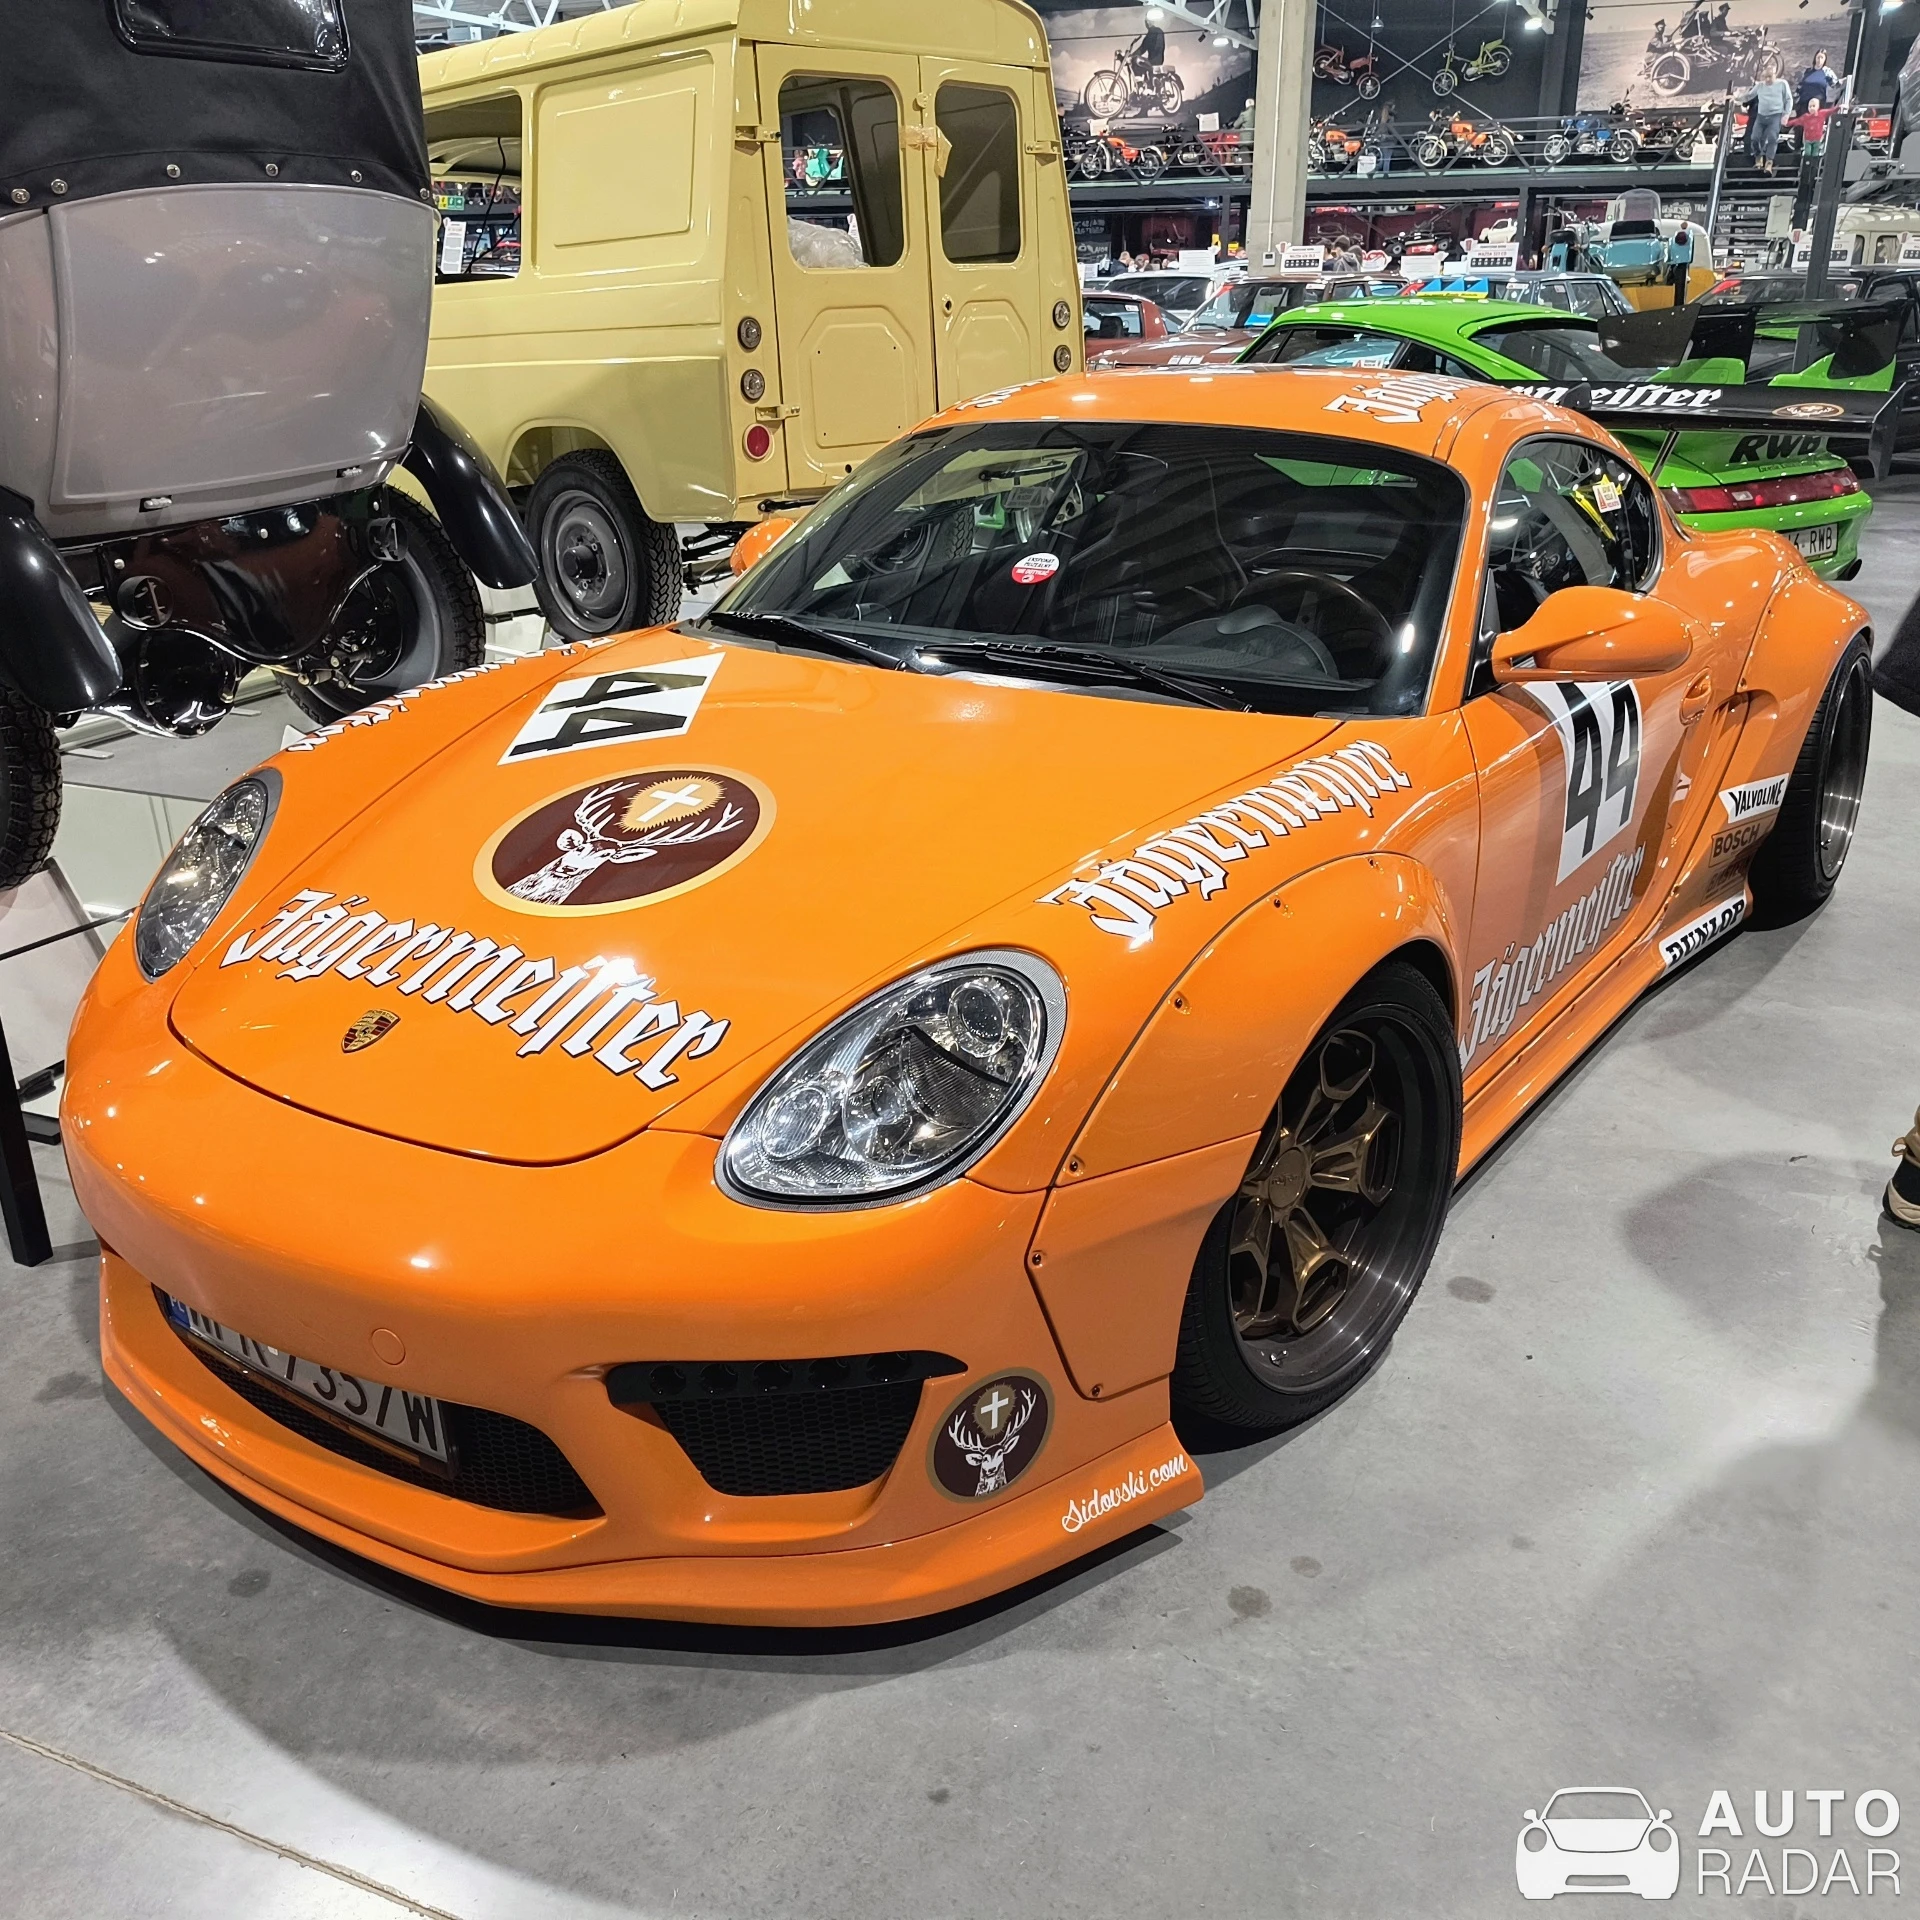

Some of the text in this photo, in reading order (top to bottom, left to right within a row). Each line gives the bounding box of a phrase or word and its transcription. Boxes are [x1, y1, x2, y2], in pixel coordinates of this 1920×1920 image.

[1729, 434, 1821, 463] RWB
[1810, 526, 1832, 554] RWB
[508, 671, 707, 757] 44
[1565, 681, 1639, 858] 44
[1728, 778, 1785, 817] VALVOLINE
[1034, 739, 1412, 940] Jägermeister
[1713, 823, 1760, 857] BOSCH
[1666, 899, 1745, 967] DUNLOP
[219, 888, 732, 1091] Jägermeister
[1061, 1454, 1189, 1532] Sidovski.com
